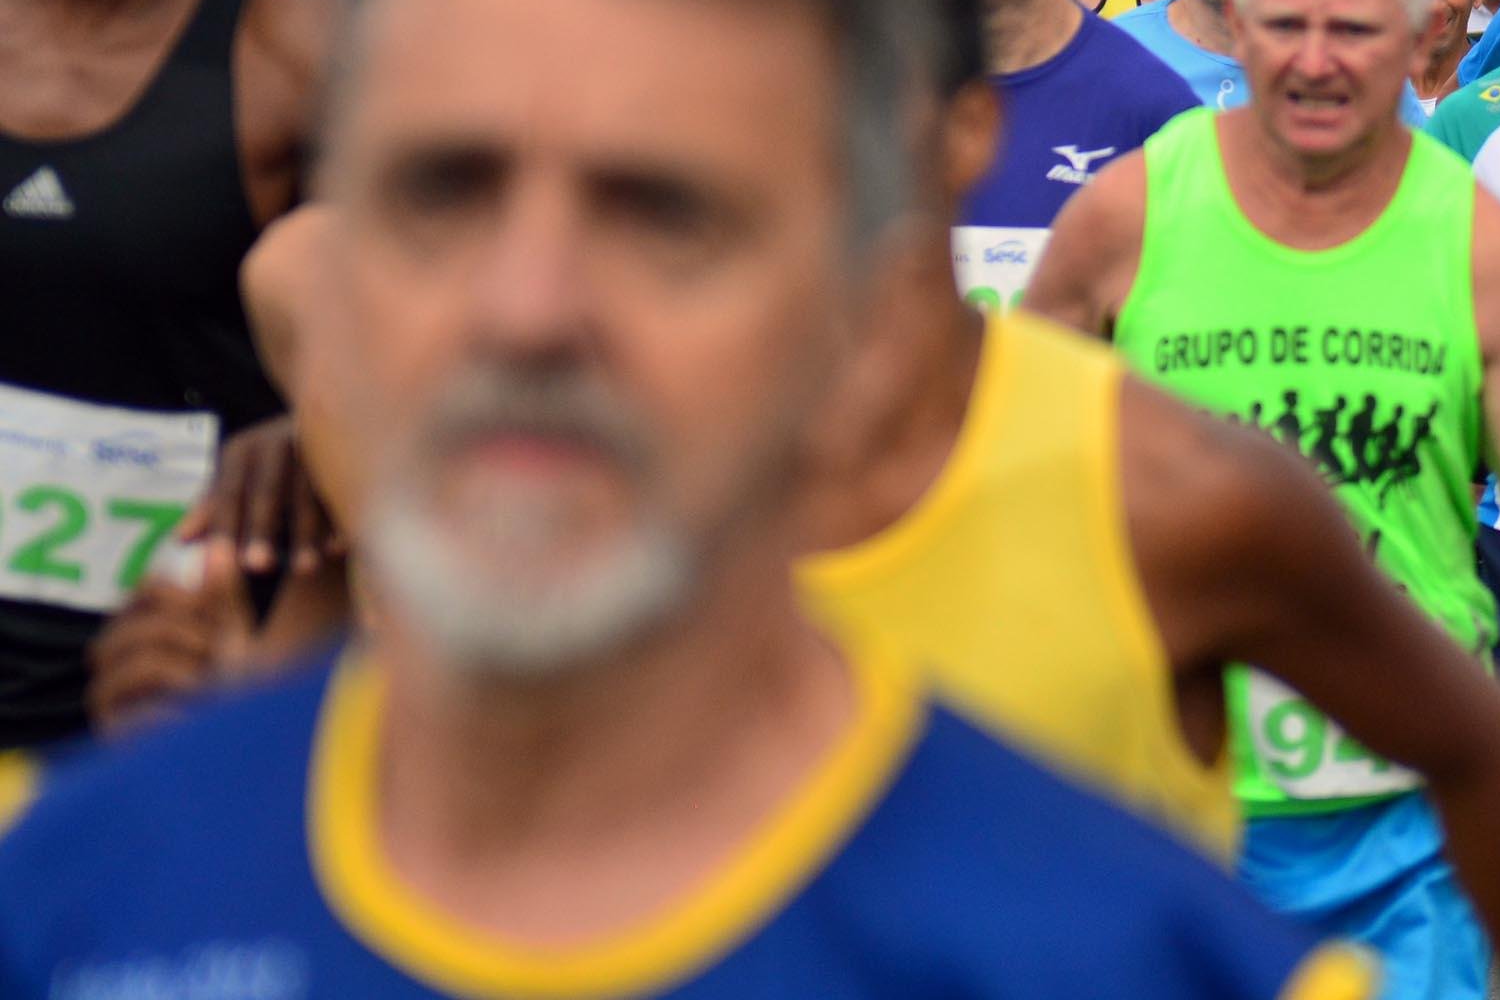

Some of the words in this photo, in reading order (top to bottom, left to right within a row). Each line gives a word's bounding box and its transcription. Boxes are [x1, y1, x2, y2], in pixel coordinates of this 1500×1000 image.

[1154, 328, 1258, 372] GRUPO
[1271, 327, 1309, 364] DE
[1321, 327, 1447, 375] CORRIDA
[0, 484, 188, 593] 27
